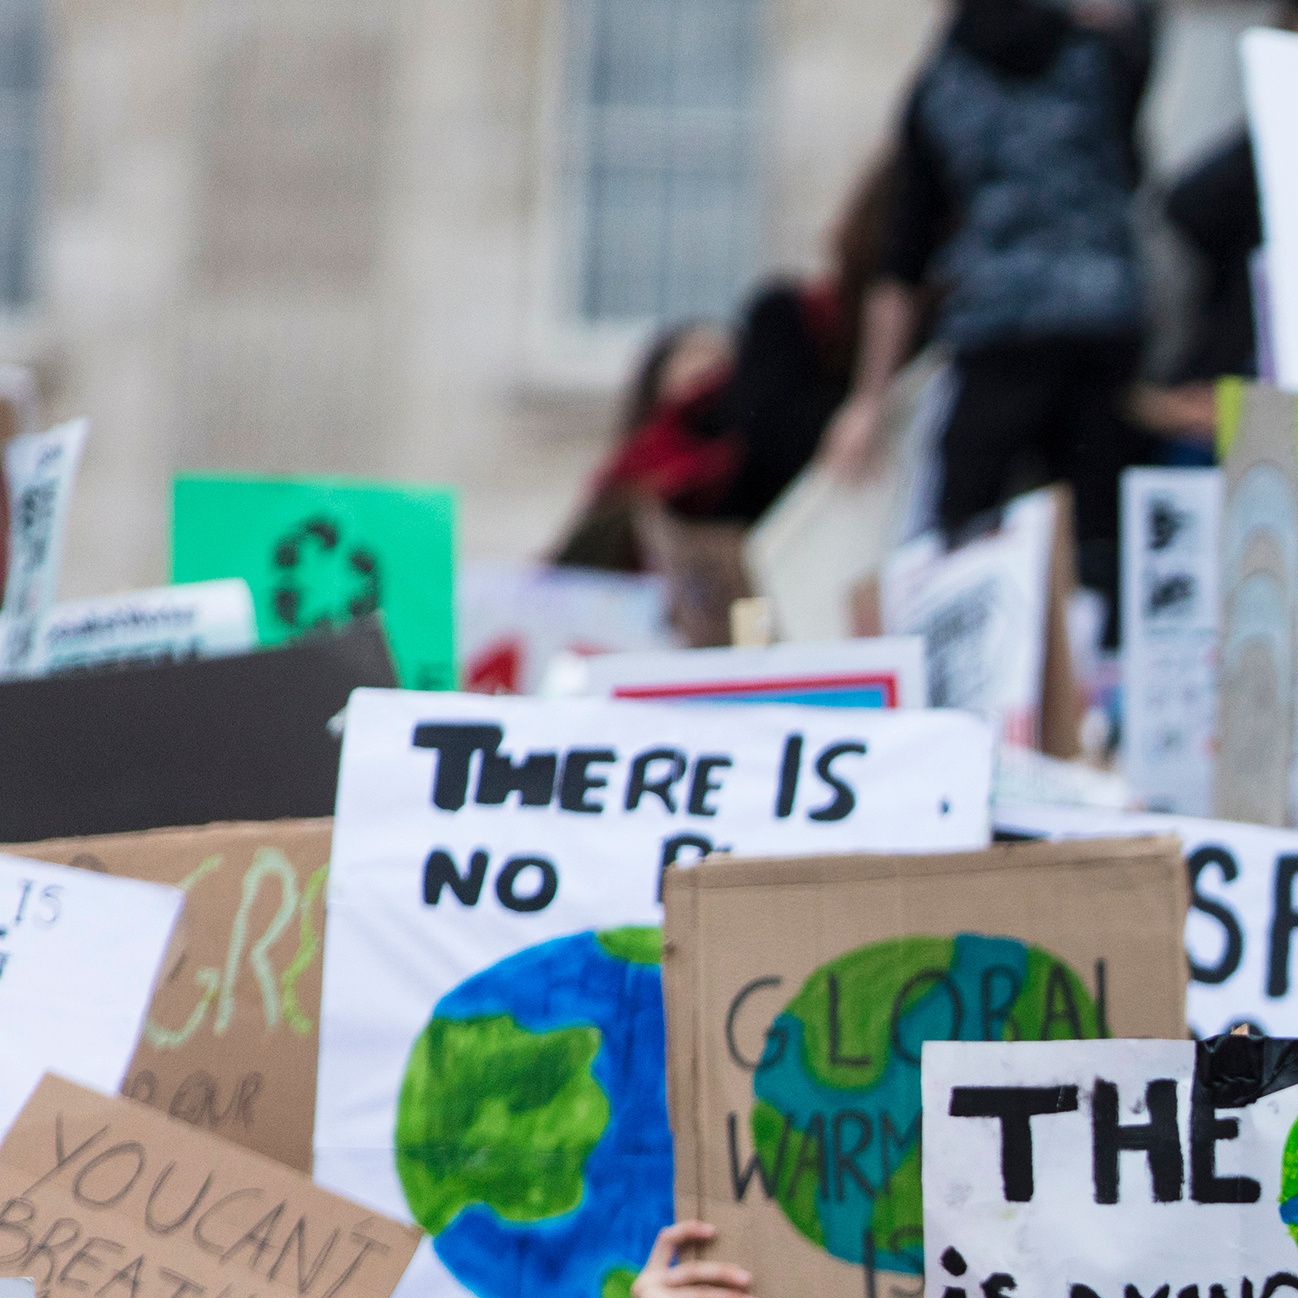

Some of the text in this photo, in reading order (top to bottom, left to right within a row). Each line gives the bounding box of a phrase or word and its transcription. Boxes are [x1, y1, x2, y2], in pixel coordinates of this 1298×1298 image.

[412, 720, 869, 822] THERE IS
[420, 846, 560, 912] NO
[949, 1076, 1261, 1204] THE
